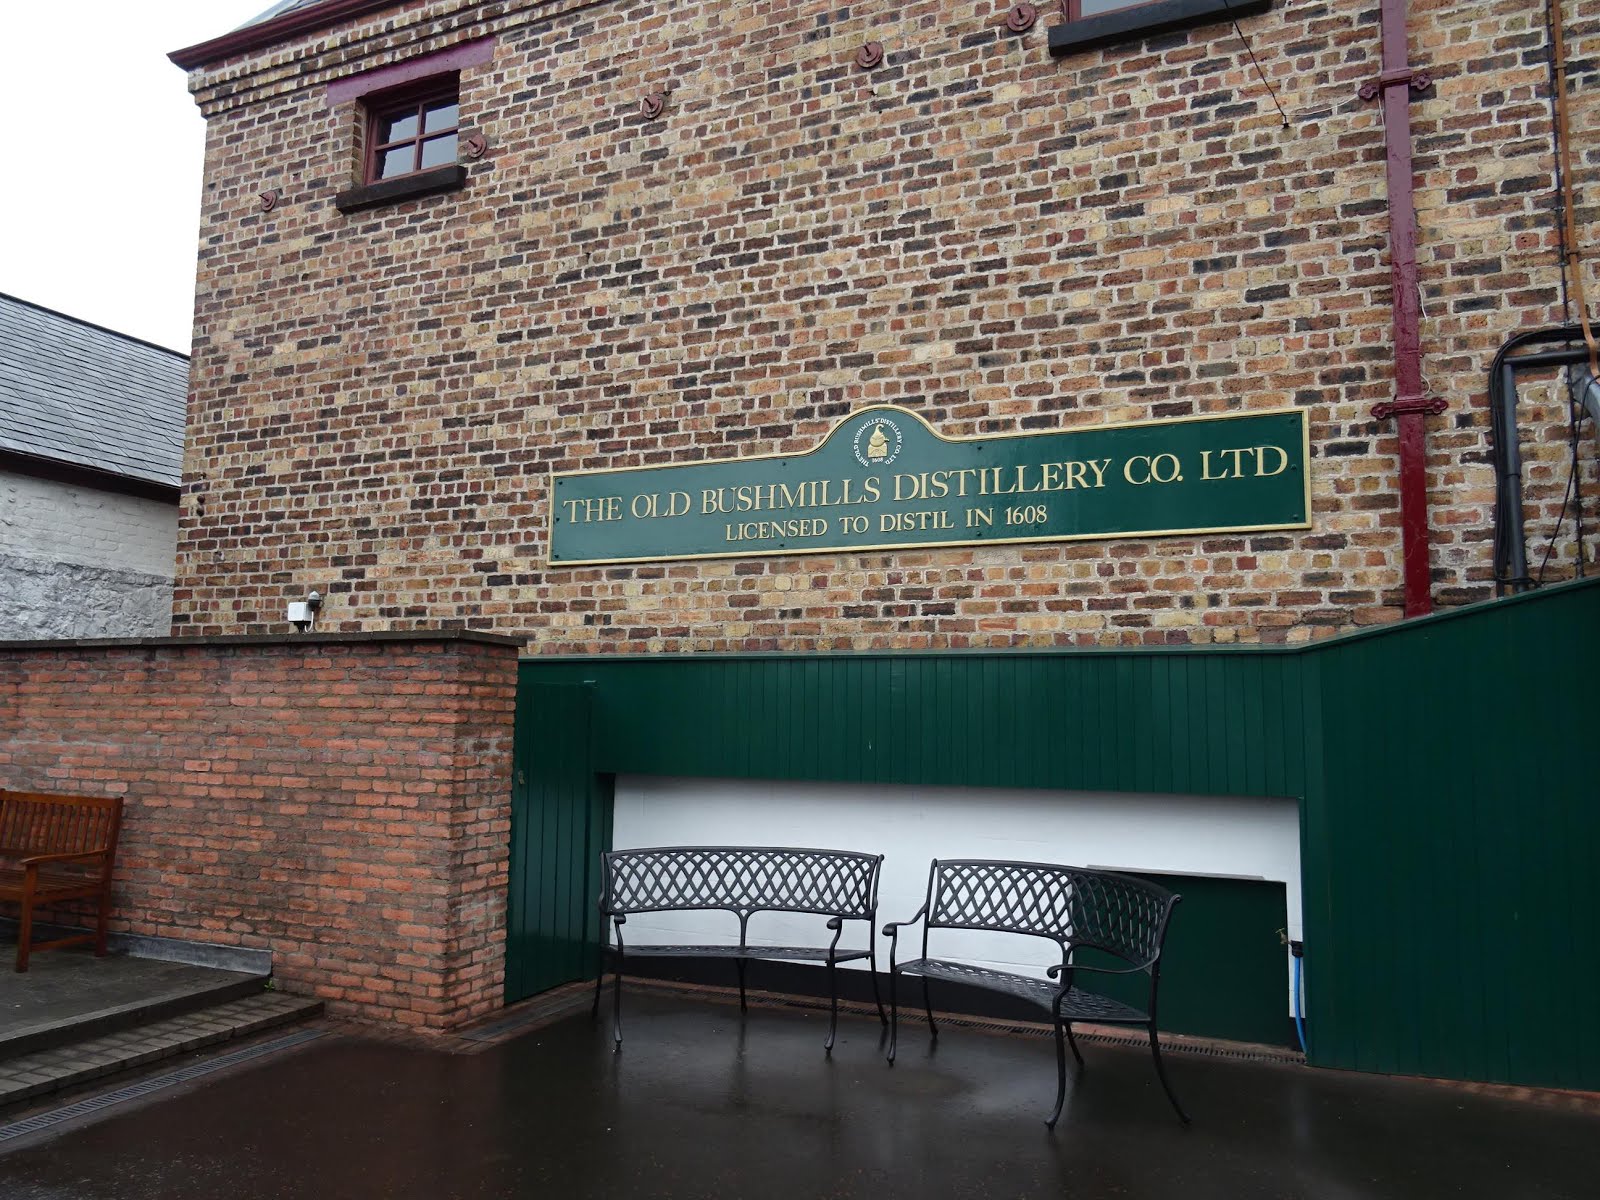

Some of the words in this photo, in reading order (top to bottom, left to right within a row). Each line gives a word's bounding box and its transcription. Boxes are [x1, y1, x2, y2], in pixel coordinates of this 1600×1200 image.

[563, 496, 623, 524] THE
[631, 491, 692, 519] OLD
[701, 476, 881, 515] BUSHMILLS
[893, 458, 1112, 502] DISTILLERY
[1123, 453, 1183, 486] CO.
[1200, 445, 1289, 481] LTD
[725, 517, 828, 542] LICENSED
[838, 515, 869, 535] TO
[879, 511, 954, 533] DISTIL
[966, 507, 994, 528] IN
[1005, 505, 1048, 526] 1608
